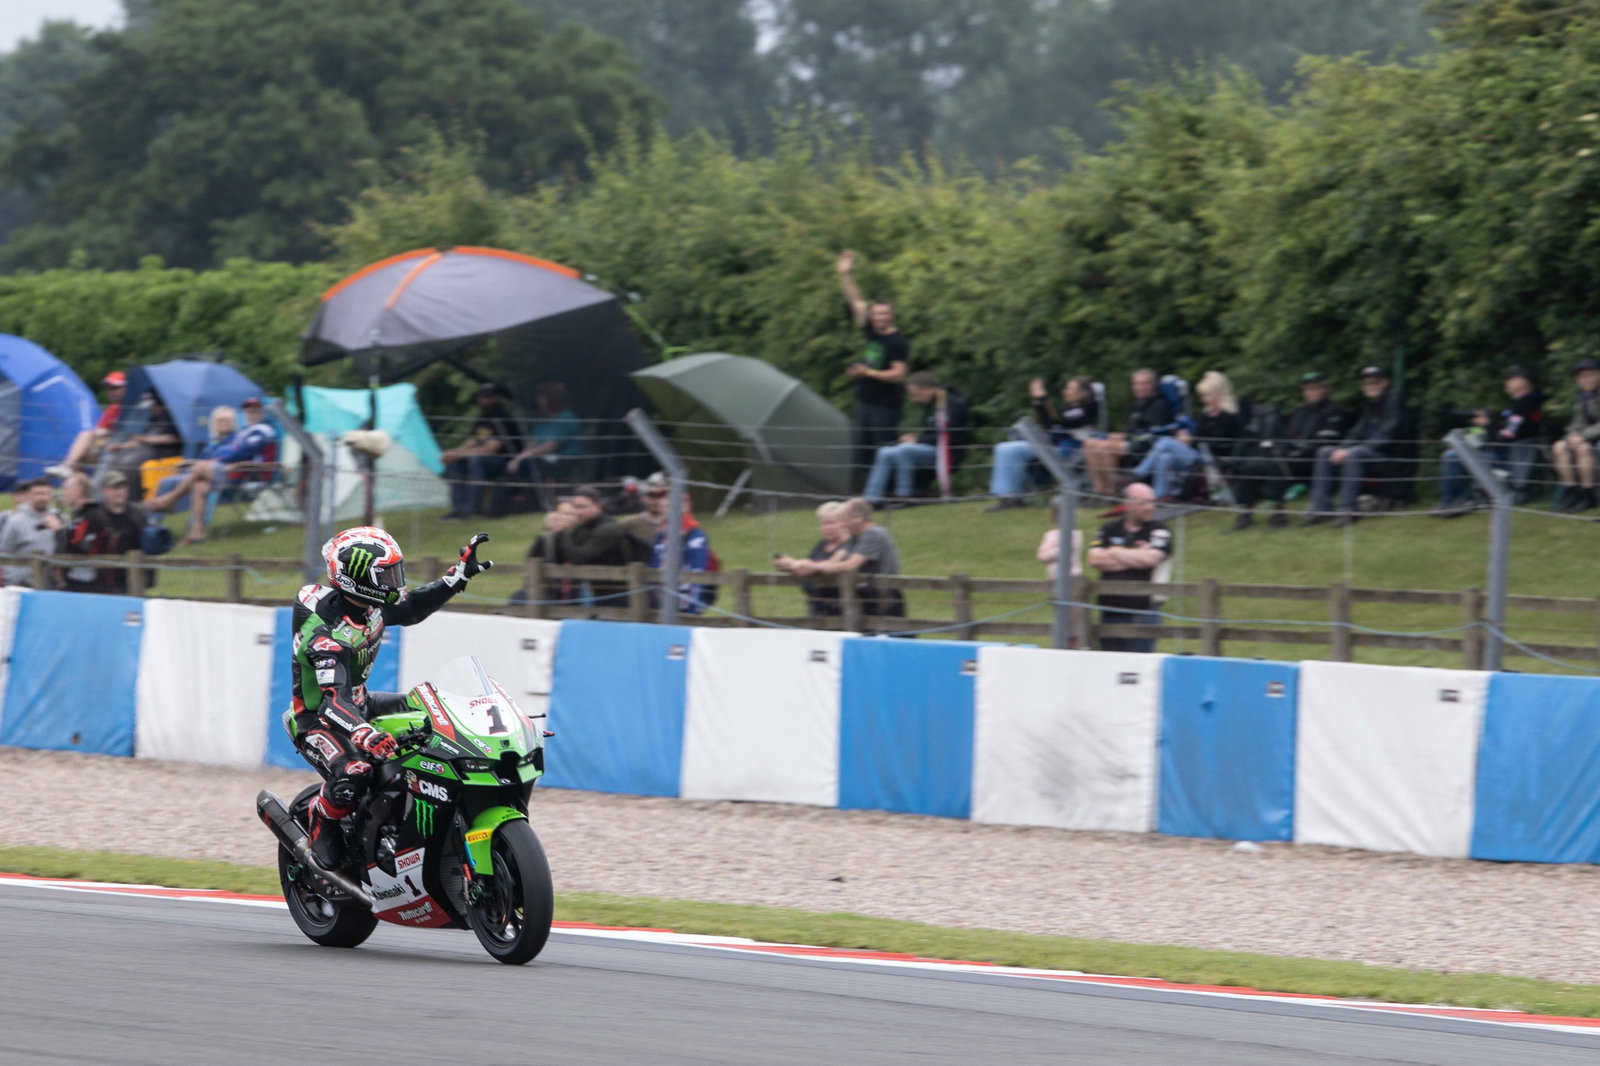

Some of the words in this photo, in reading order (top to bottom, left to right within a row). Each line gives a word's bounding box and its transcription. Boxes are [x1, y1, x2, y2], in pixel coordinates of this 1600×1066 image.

[486, 705, 508, 735] 1
[419, 760, 436, 771] elf
[418, 779, 449, 802] CMS
[397, 853, 421, 869] SHOWA
[371, 883, 406, 901] Kawasaki
[404, 874, 422, 897] 1
